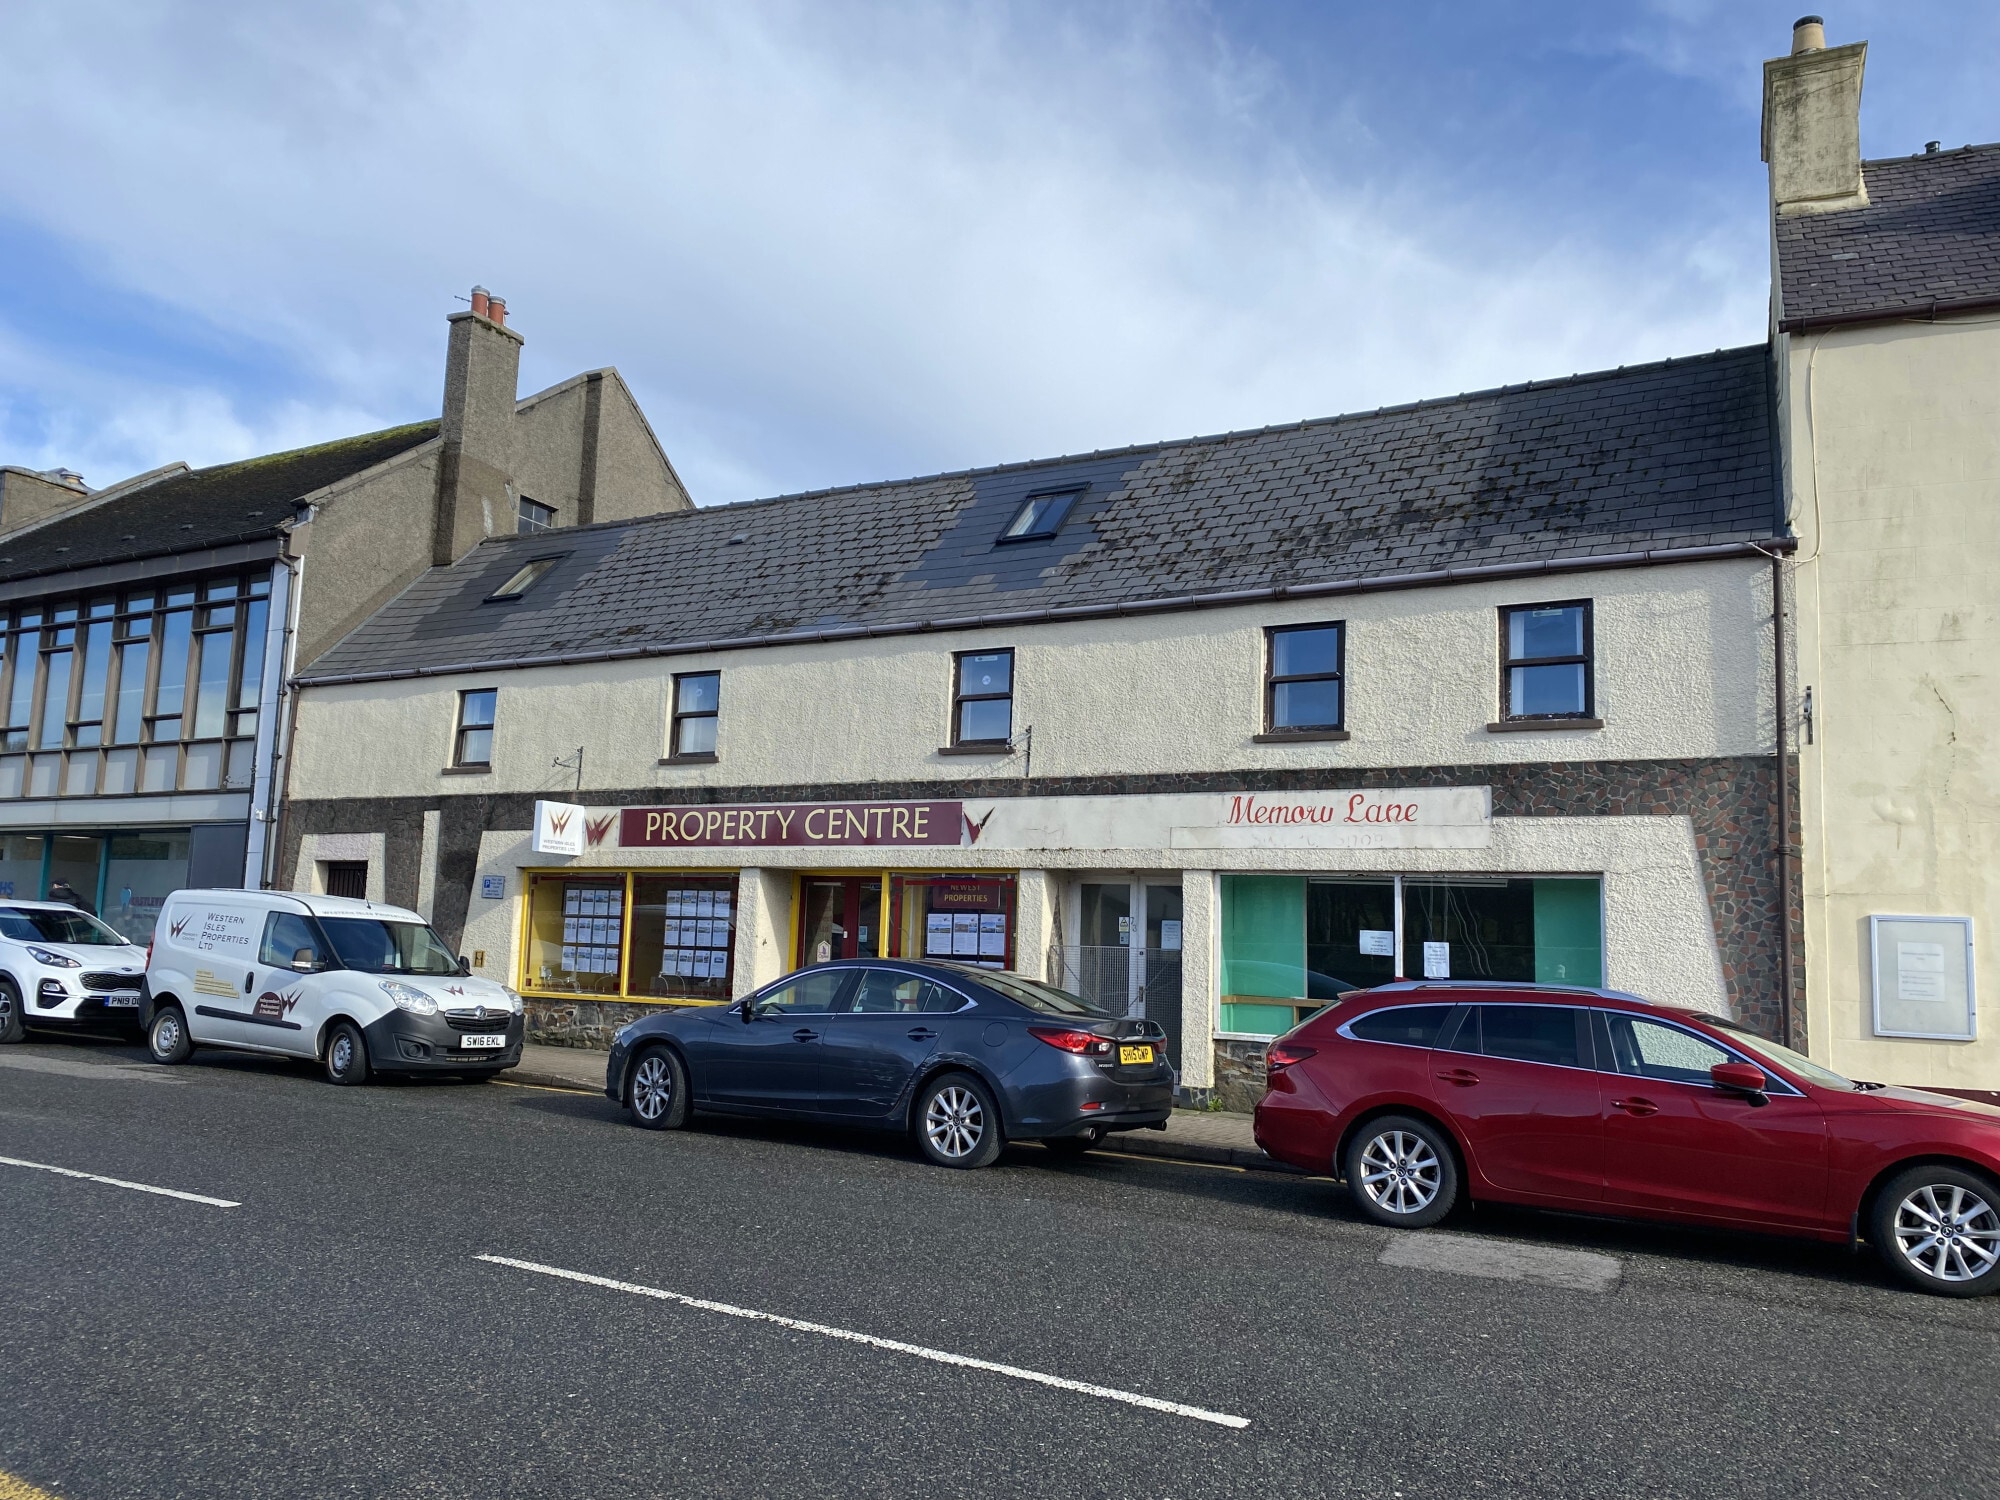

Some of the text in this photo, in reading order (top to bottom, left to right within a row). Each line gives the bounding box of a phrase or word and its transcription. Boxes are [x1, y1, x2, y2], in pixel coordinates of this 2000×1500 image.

[1343, 793, 1419, 823] Lane
[645, 806, 931, 841] PROPERTY CENTRE
[944, 894, 988, 903] PROPERTIES
[207, 912, 245, 924] WESTERN
[203, 922, 226, 932] ISLES
[201, 931, 249, 945] PROPERTIES
[198, 941, 213, 951] LTD
[112, 997, 130, 1006] PN19
[466, 1036, 500, 1046] SW16 EKL
[1122, 1048, 1137, 1061] SH15
